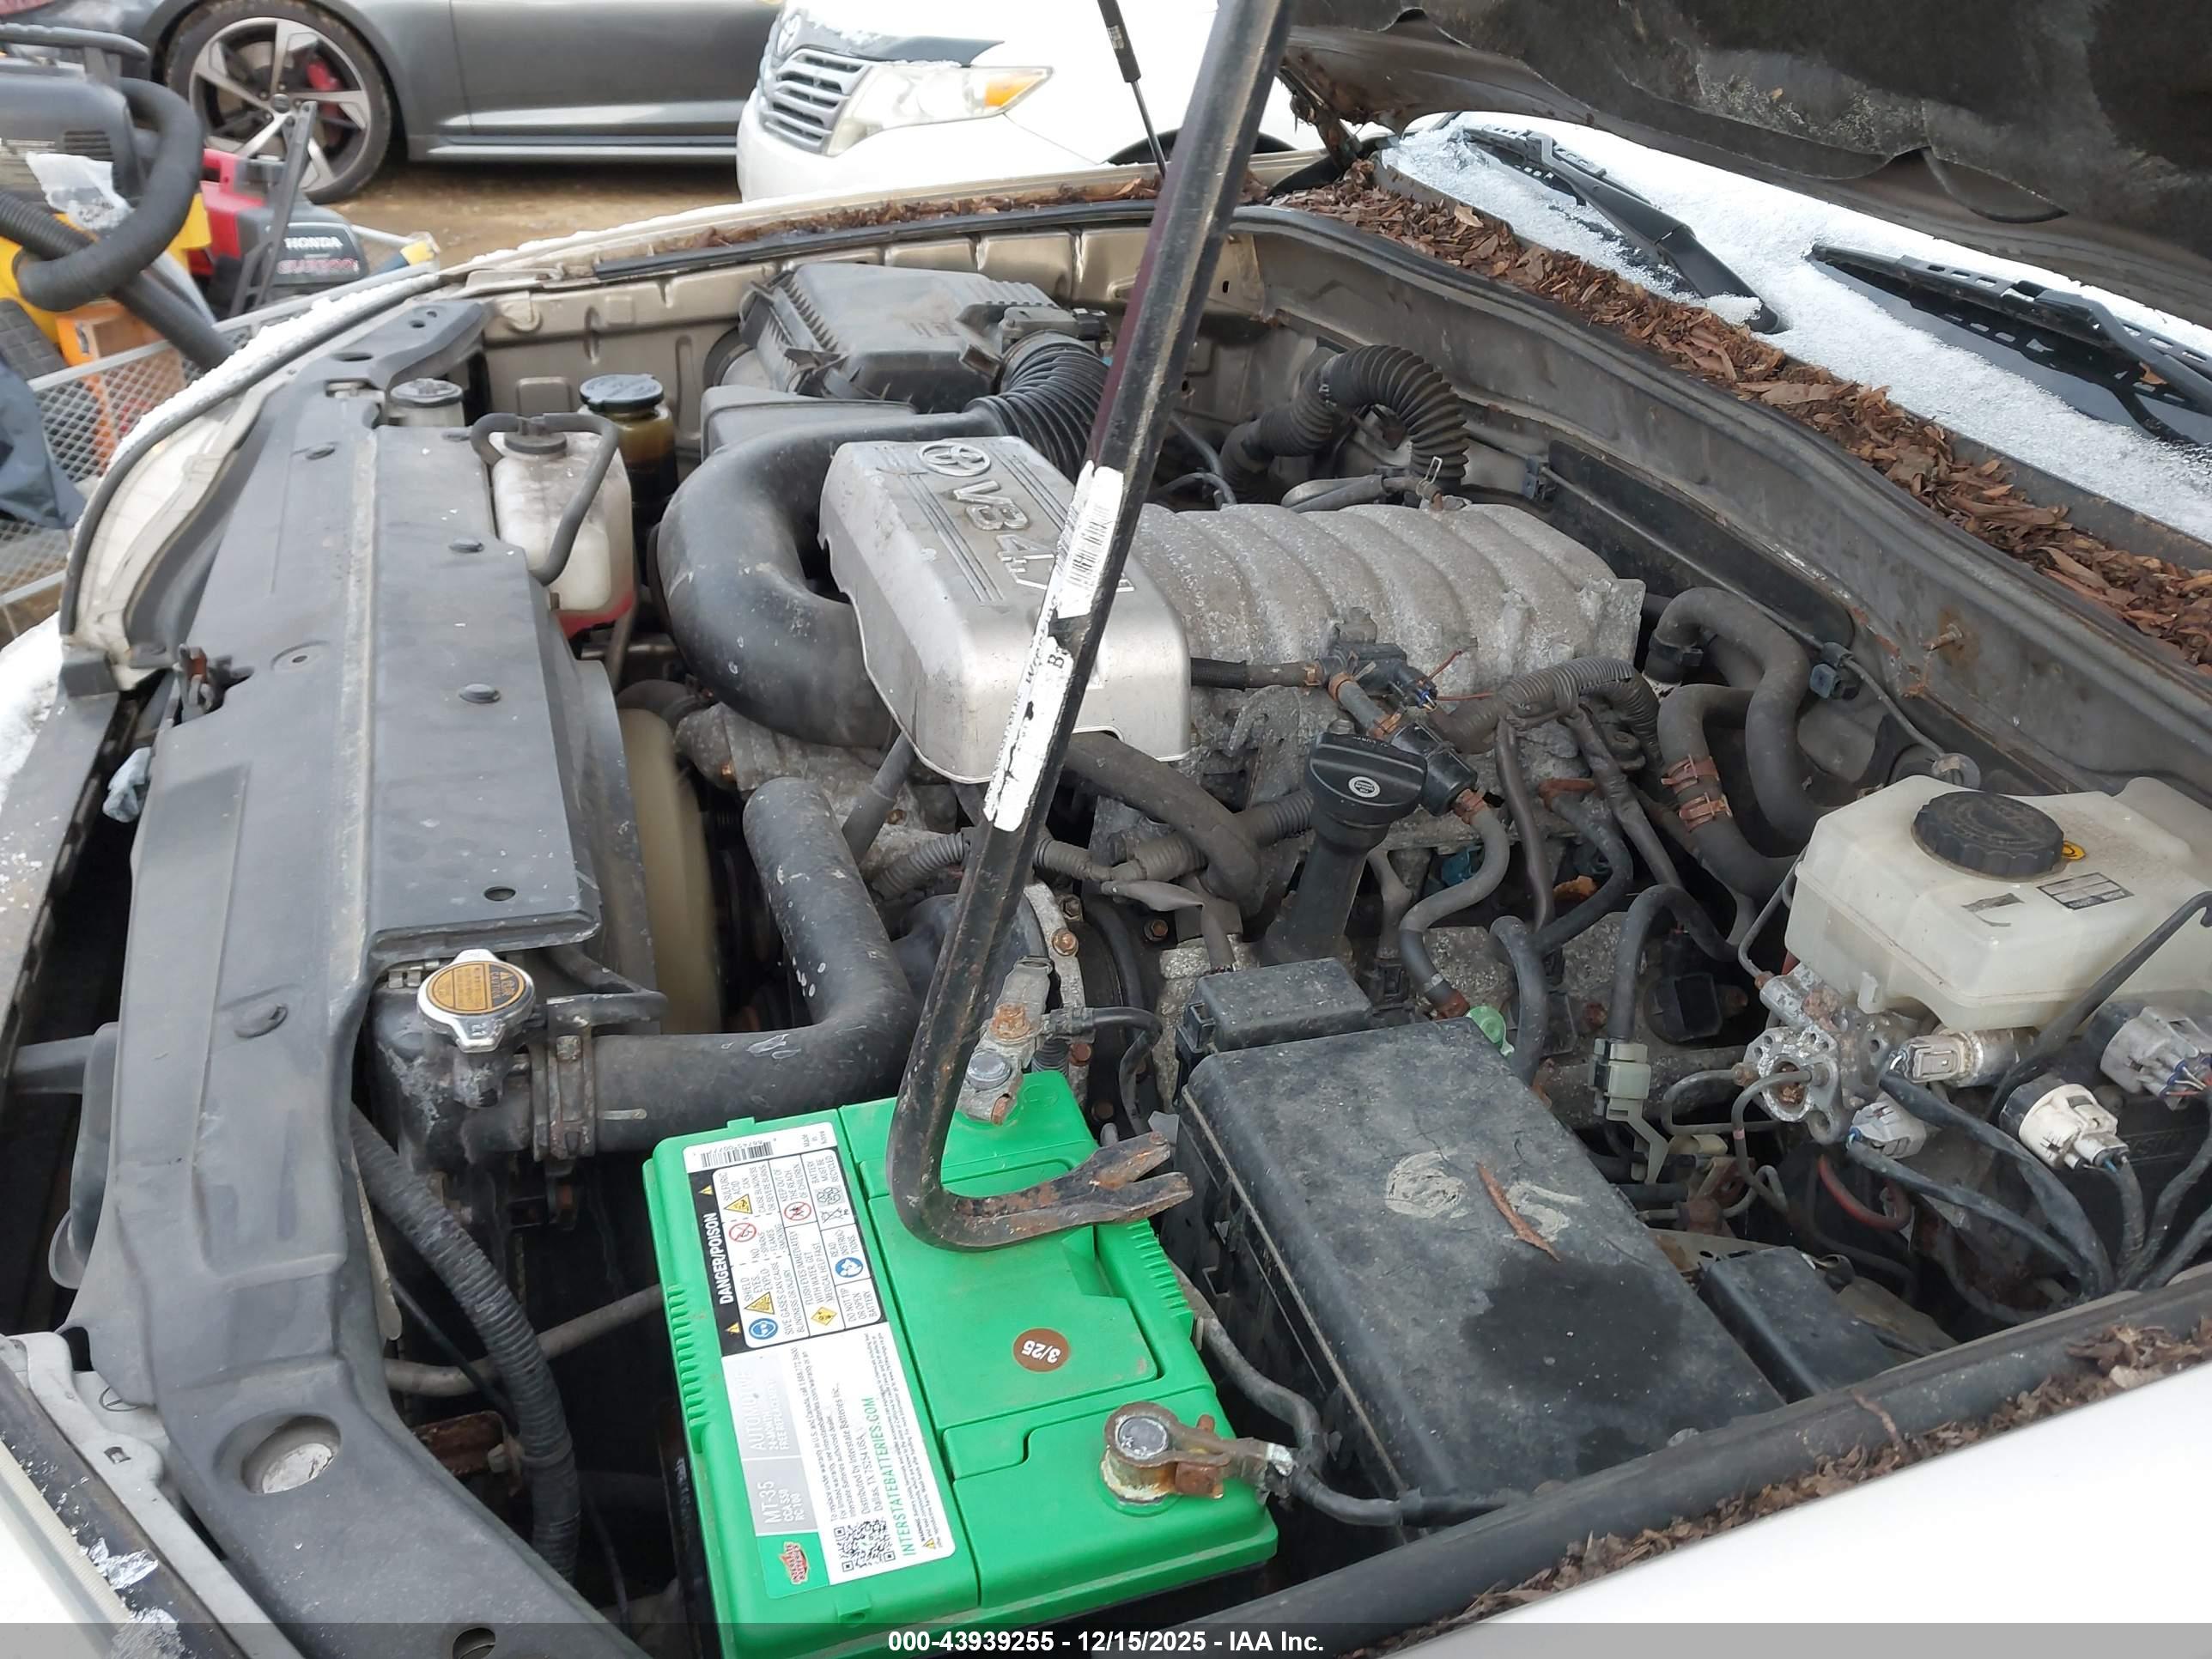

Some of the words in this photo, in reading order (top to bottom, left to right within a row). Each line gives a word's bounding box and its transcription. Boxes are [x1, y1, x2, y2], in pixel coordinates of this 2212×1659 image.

[283, 237, 343, 249] HONDA
[953, 480, 1030, 531] V8
[816, 1158, 824, 1166] BE
[783, 1169, 795, 1188] REACH
[805, 1160, 819, 1184] BATTERY
[817, 1166, 829, 1181] MUST
[730, 1180, 741, 1195] ACID
[740, 1176, 750, 1188] CAN
[775, 1176, 785, 1187] OUT
[788, 1189, 799, 1200] THE
[750, 1248, 760, 1259] NO
[787, 1229, 805, 1268] IMMEDIATELY
[828, 1242, 839, 1257] READ
[702, 1212, 734, 1304] DANGER/POISON
[815, 1256, 827, 1273] HELP
[797, 1268, 809, 1285] EYES
[739, 1276, 754, 1302] SHIELD
[774, 1280, 785, 1293] CAN
[801, 1285, 814, 1305] FLUSH
[812, 1285, 824, 1304] WITH
[819, 1273, 835, 1302] MEDICAL
[839, 1286, 849, 1297] TIP
[775, 1293, 790, 1318] GASES
[842, 1297, 854, 1311] NOT
[852, 1291, 864, 1310] OPEN
[846, 1312, 856, 1322] DO
[856, 1309, 866, 1320] OR
[781, 1318, 794, 1335] SIVE
[1021, 1340, 1061, 1364] 3/25
[734, 1371, 767, 1453] AUTOMOTIVE
[833, 1398, 849, 1429] Batteries
[776, 1430, 790, 1450] FREE
[841, 1429, 858, 1463] Interstate
[860, 1395, 916, 1558] INTERSTATEBATTERIES.COM
[756, 1479, 782, 1525] MT-35
[852, 1474, 871, 1515] Distributed
[781, 1504, 794, 1522] CCA
[793, 1507, 805, 1521] RC
